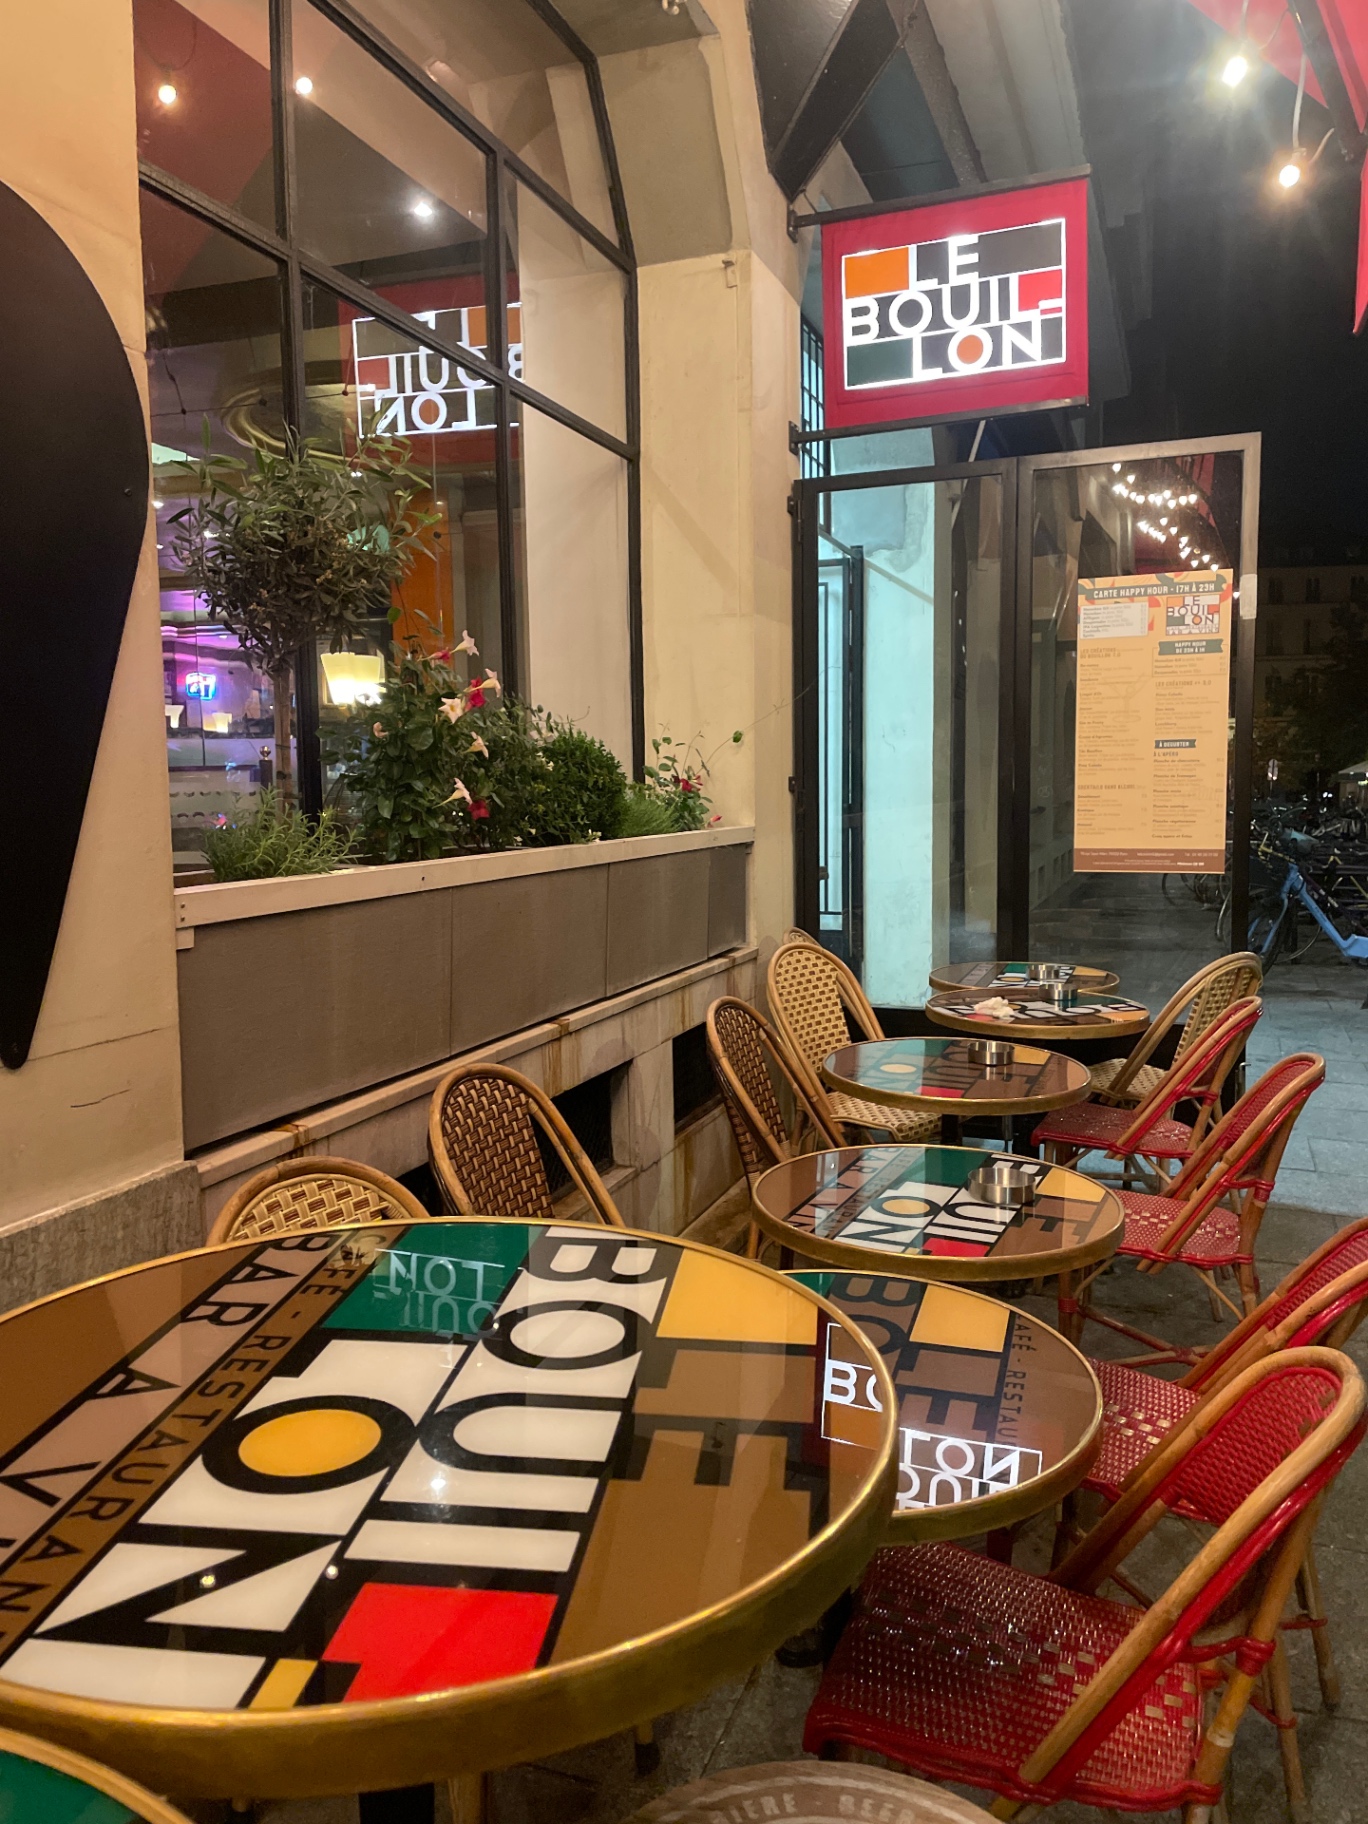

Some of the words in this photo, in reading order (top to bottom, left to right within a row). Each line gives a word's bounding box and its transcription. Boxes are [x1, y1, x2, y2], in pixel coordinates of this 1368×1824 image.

[908, 234, 979, 292] LE
[912, 319, 1042, 379] LON
[1093, 589, 1118, 599] CARTE
[1120, 587, 1145, 597] HAPPY
[1147, 585, 1168, 595] HOUR
[1176, 584, 1190, 593] 17H
[1199, 583, 1215, 592] 23H
[1183, 613, 1214, 626] LON
[838, 1178, 960, 1247] LON
[178, 1232, 332, 1326] BAR
[1010, 1314, 1037, 1352] AFÉ
[0, 1333, 292, 1645] RESTAURAN
[30, 1325, 472, 1660] LON
